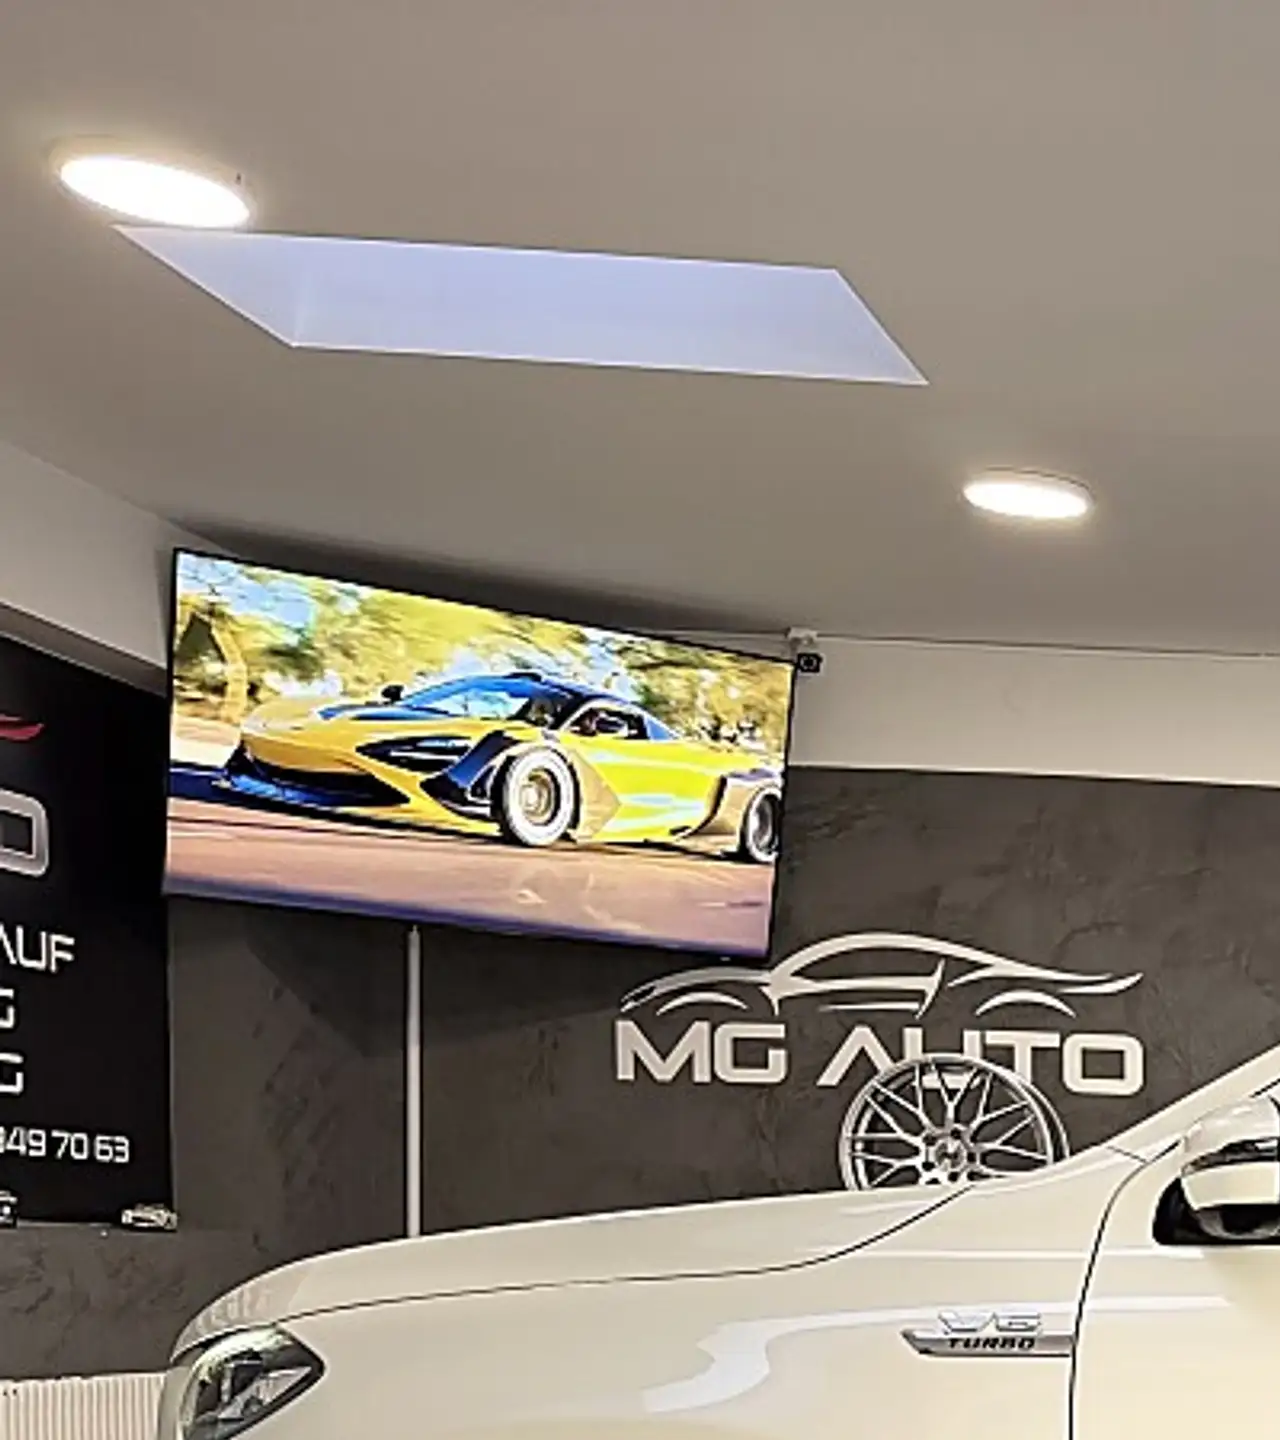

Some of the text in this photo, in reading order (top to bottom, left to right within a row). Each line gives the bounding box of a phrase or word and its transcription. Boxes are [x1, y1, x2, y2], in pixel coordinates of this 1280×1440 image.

[616, 1020, 1145, 1096] MG AUTO
[51, 1130, 89, 1160] 70
[94, 1136, 130, 1163] 63
[949, 1338, 1036, 1349] TURBO
